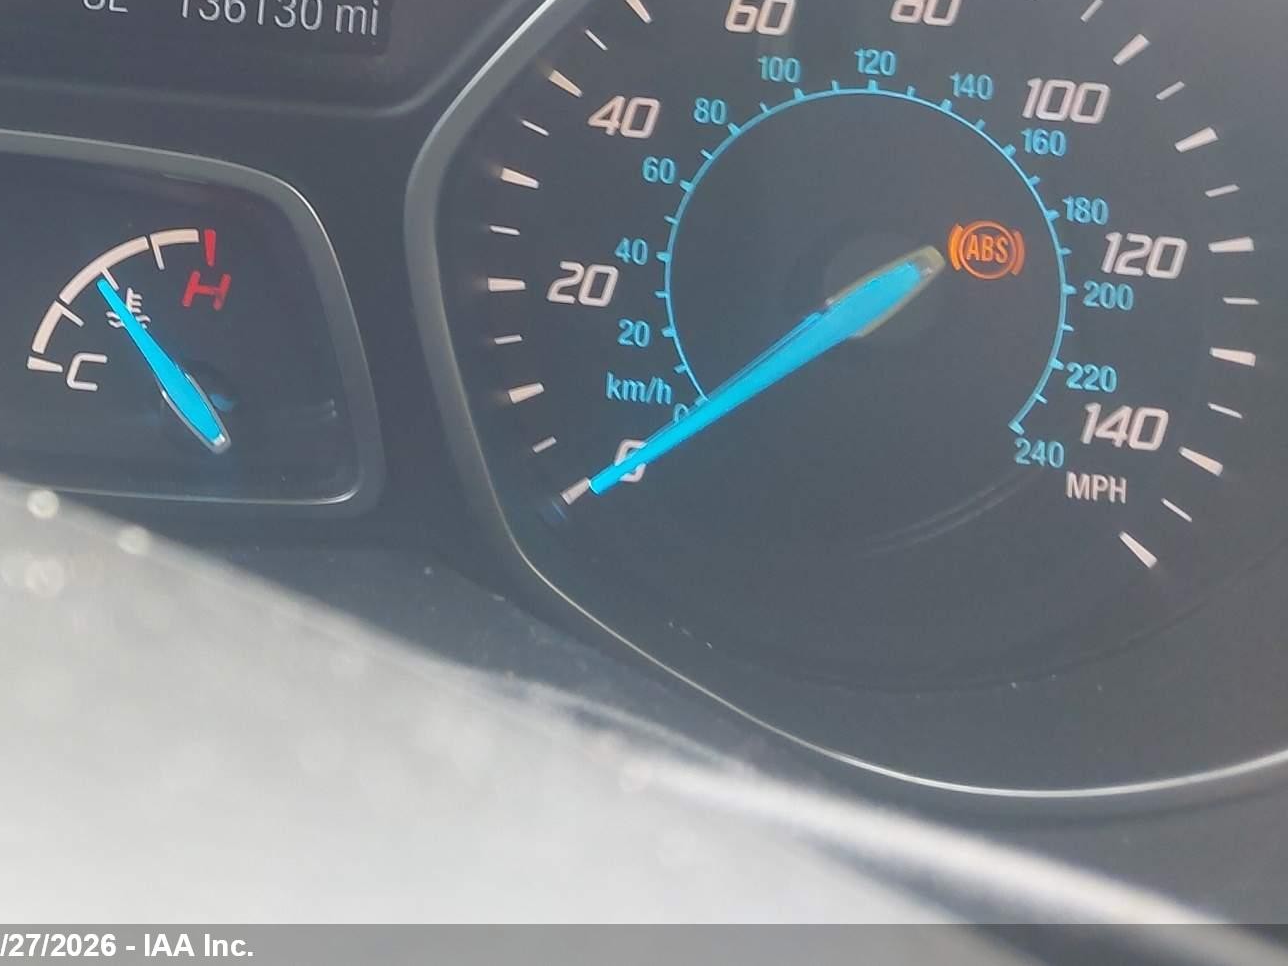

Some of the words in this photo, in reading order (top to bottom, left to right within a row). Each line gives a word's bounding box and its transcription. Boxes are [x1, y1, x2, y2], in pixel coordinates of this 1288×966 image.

[758, 57, 801, 85] 100
[854, 49, 896, 77] 120
[951, 73, 993, 100] 140
[693, 98, 727, 126] 80
[1022, 78, 1110, 125] 100
[586, 96, 661, 140] 40
[1022, 130, 1066, 158] 160
[642, 158, 675, 186] 60
[1064, 197, 1108, 224] 180
[615, 238, 649, 266] 40
[966, 235, 1008, 264] ABS
[1099, 232, 1188, 281] 120
[182, 270, 232, 310] H
[546, 261, 619, 308] 20
[1083, 283, 1134, 311] 200
[617, 320, 651, 347] 20
[66, 352, 108, 392] C
[1065, 366, 1117, 394] 220
[606, 374, 672, 406] km/h
[1079, 403, 1168, 451] 140
[1014, 440, 1065, 468] 240
[1065, 471, 1128, 504] MPH
